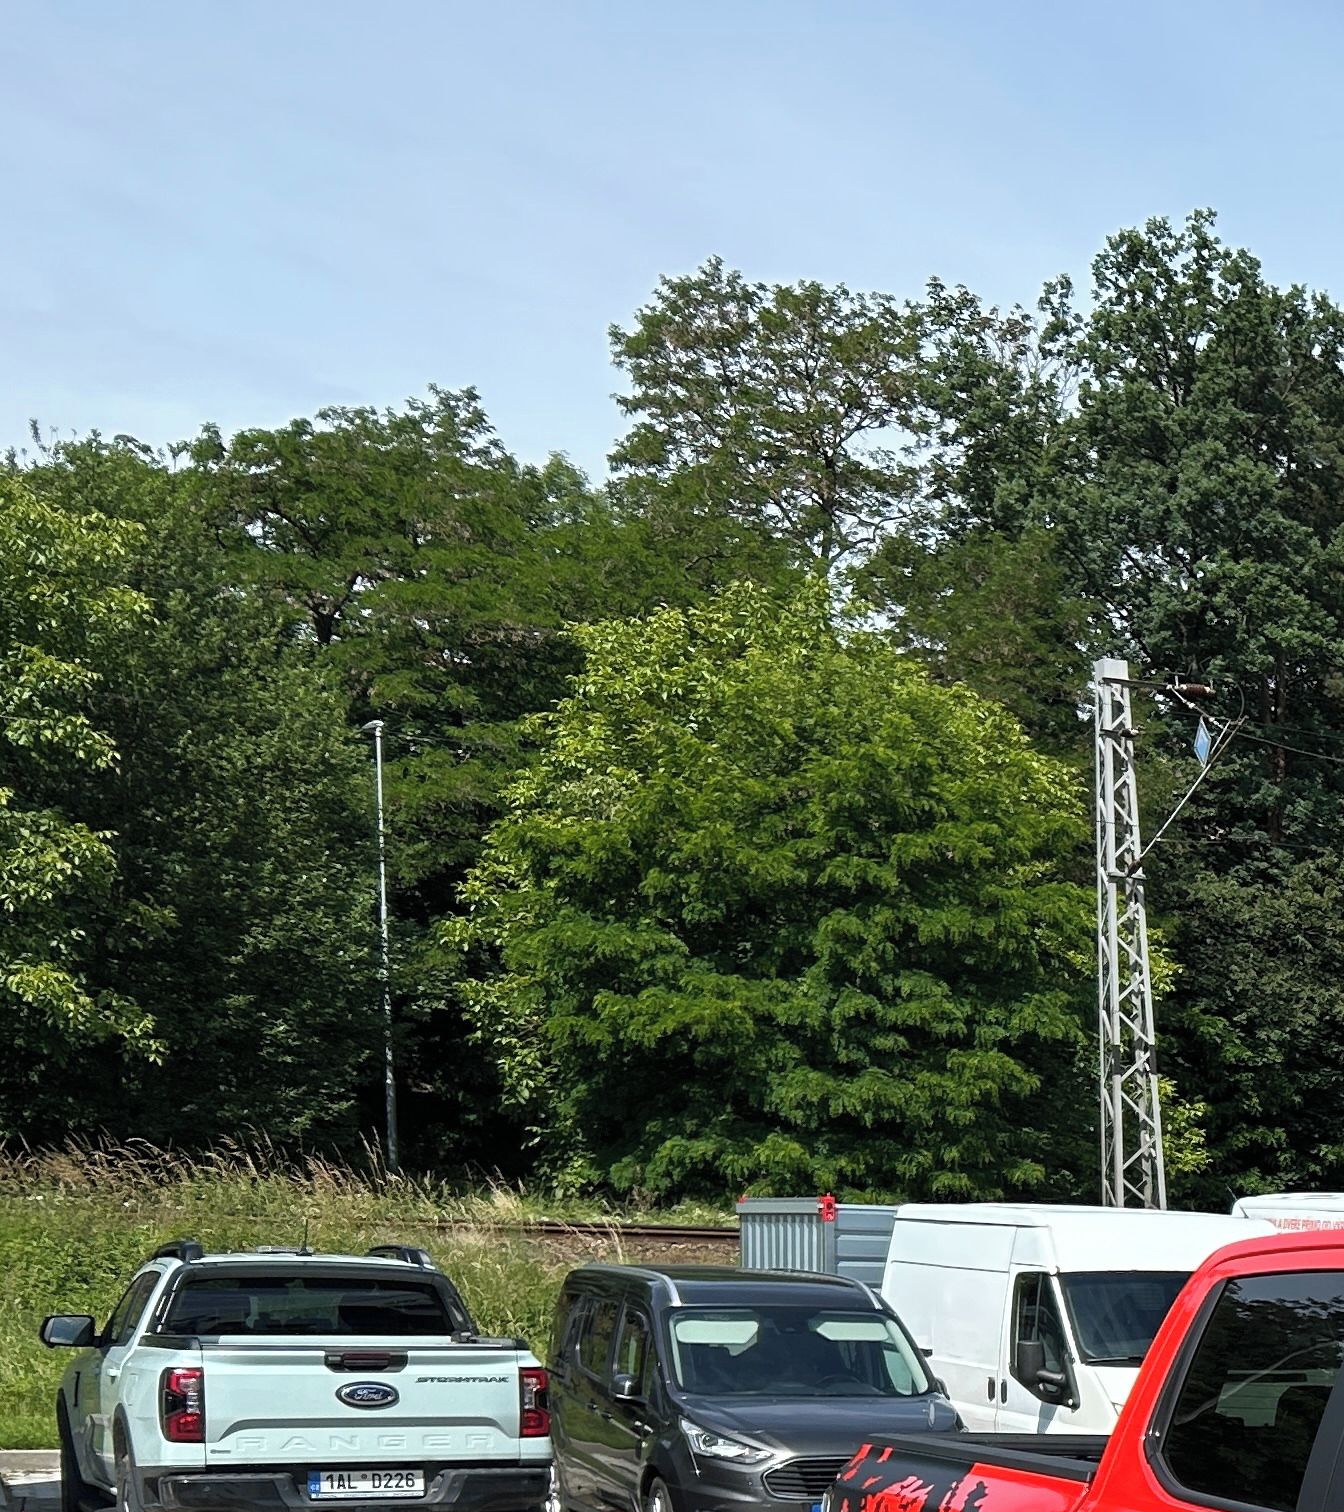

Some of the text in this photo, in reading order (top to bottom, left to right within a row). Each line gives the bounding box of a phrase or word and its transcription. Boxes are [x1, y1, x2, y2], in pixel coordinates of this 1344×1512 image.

[235, 1432, 497, 1451] RANGER
[326, 1472, 415, 1490] 1AL D226
